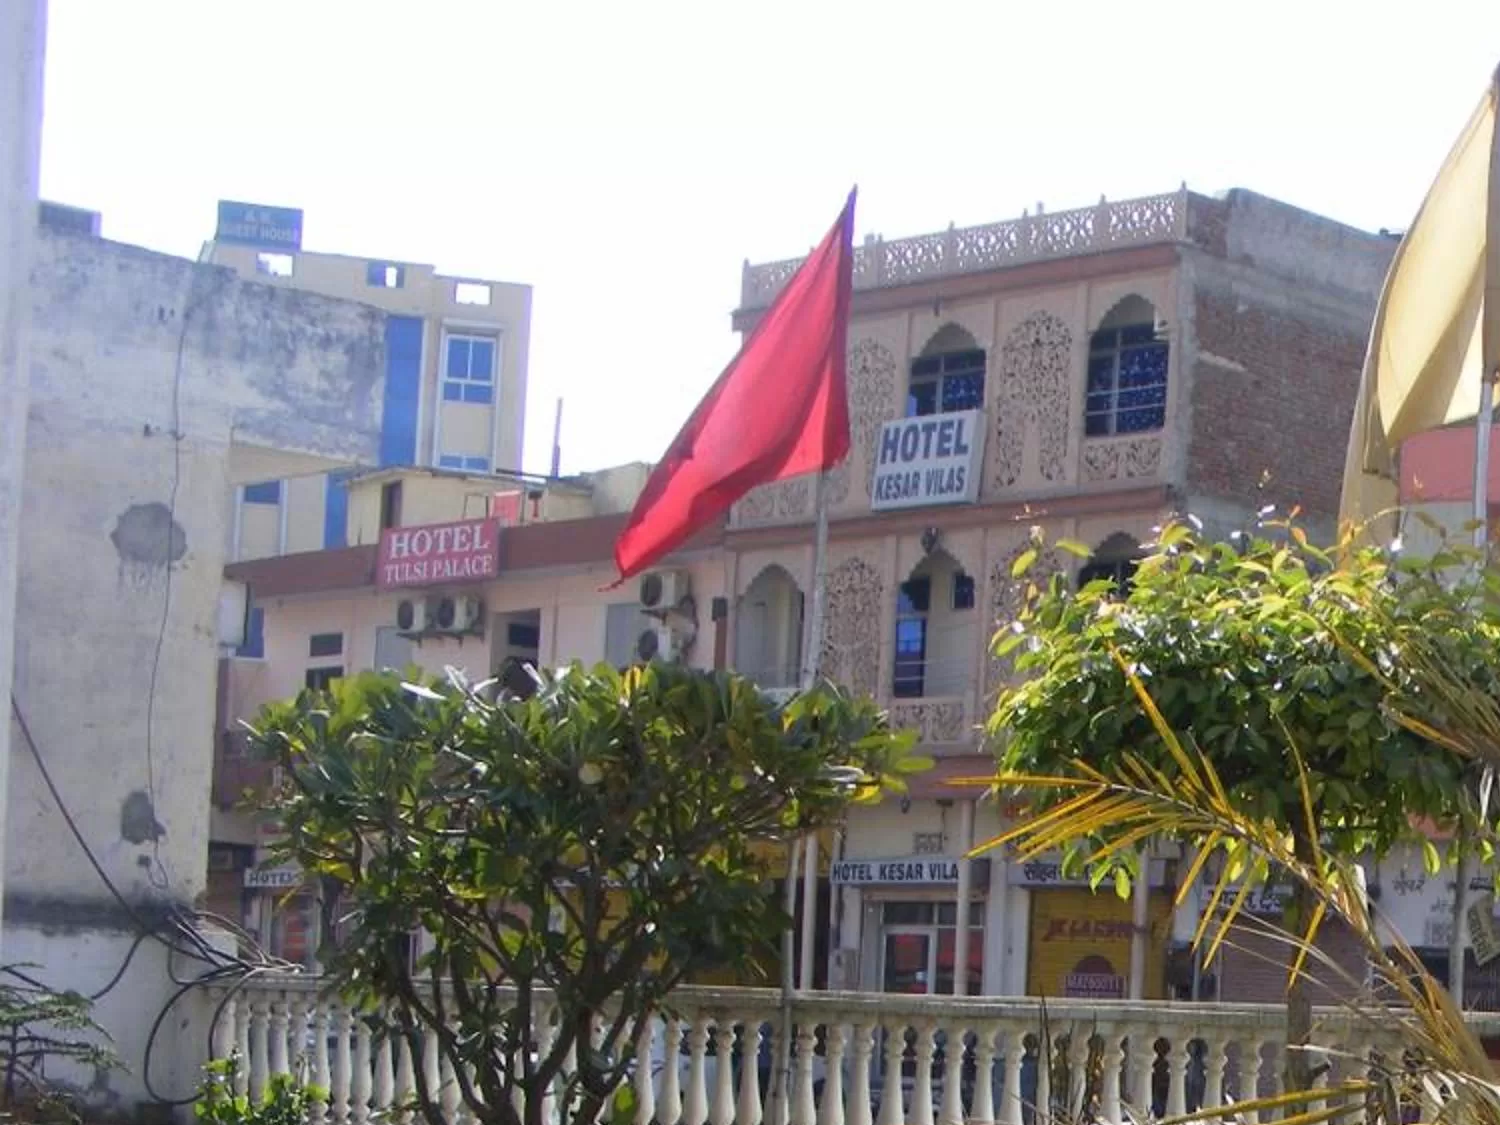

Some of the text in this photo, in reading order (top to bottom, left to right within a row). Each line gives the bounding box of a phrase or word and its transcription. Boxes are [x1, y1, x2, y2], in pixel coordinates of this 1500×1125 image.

[880, 419, 969, 465] HOTEL
[875, 465, 966, 501] KESAR VILAS
[389, 525, 490, 559] HOTEL
[384, 555, 492, 584] TULSI PALACE
[833, 863, 960, 881] HOTEL KESAR VILA
